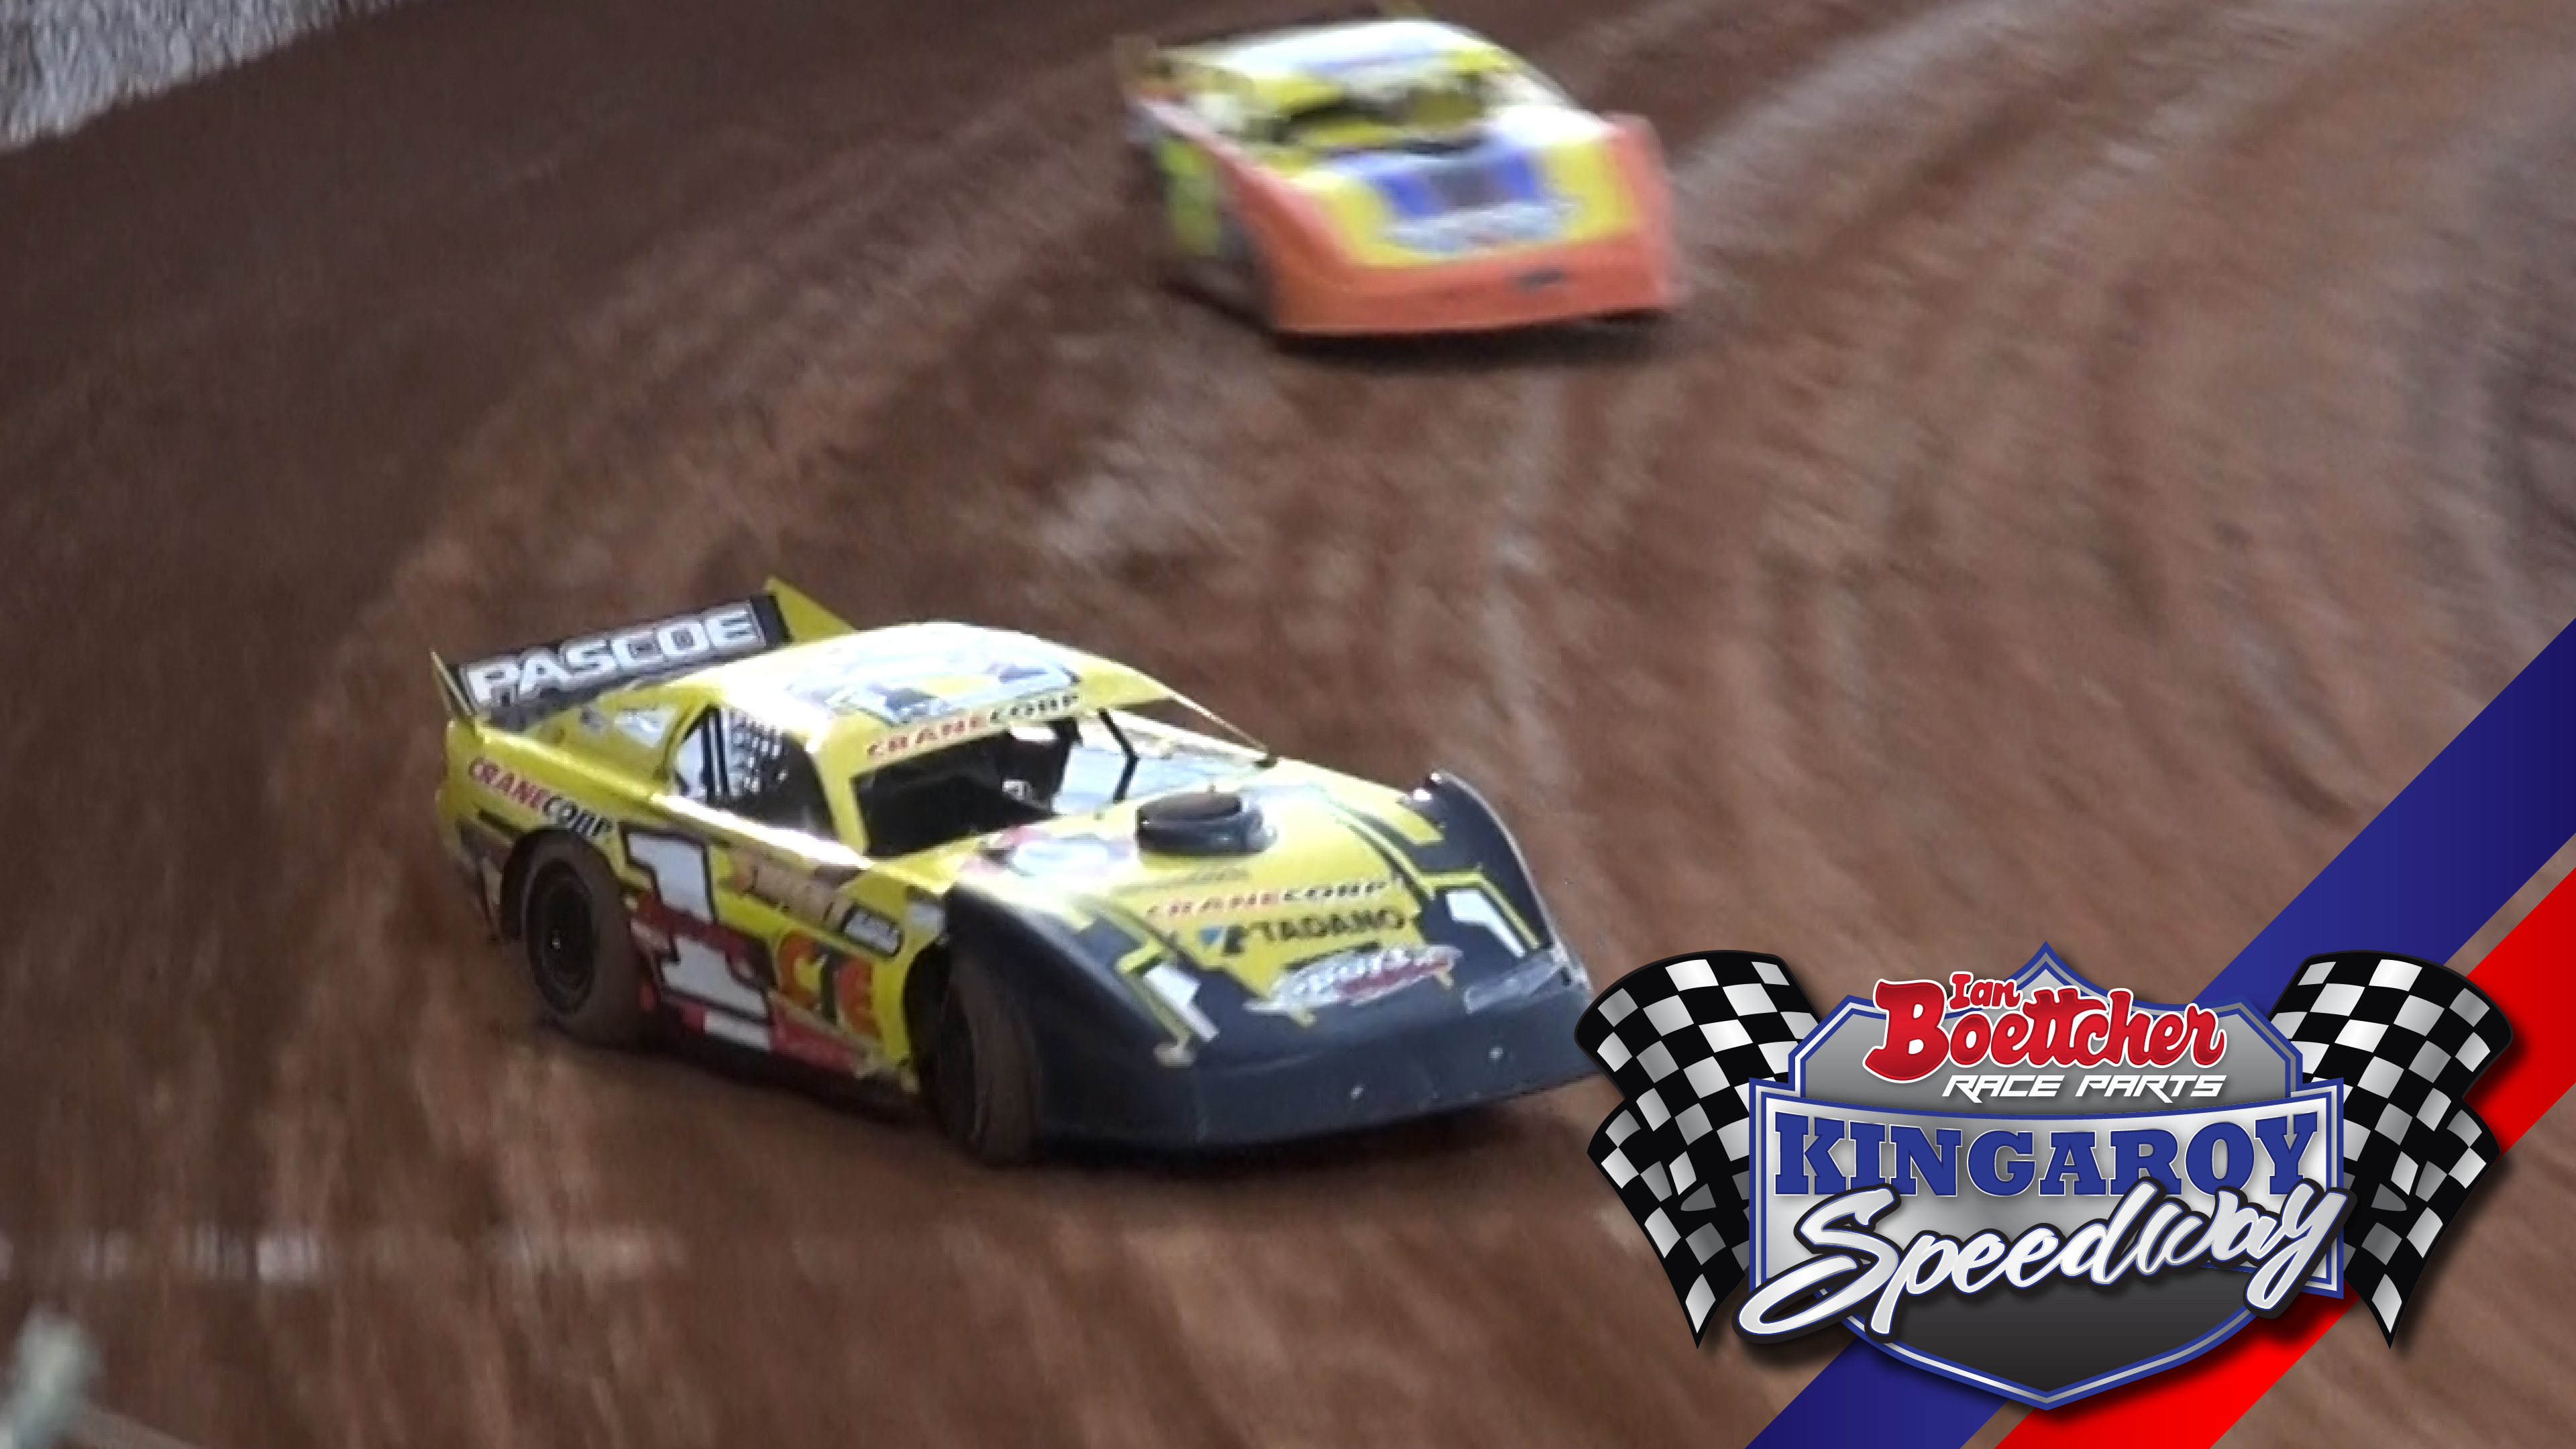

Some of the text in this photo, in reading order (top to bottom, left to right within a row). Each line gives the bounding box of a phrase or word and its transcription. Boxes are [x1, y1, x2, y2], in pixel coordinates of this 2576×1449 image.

[468, 600, 757, 710] PASCOE
[469, 756, 614, 837] CRANECORP
[1246, 906, 1406, 942] TADANO
